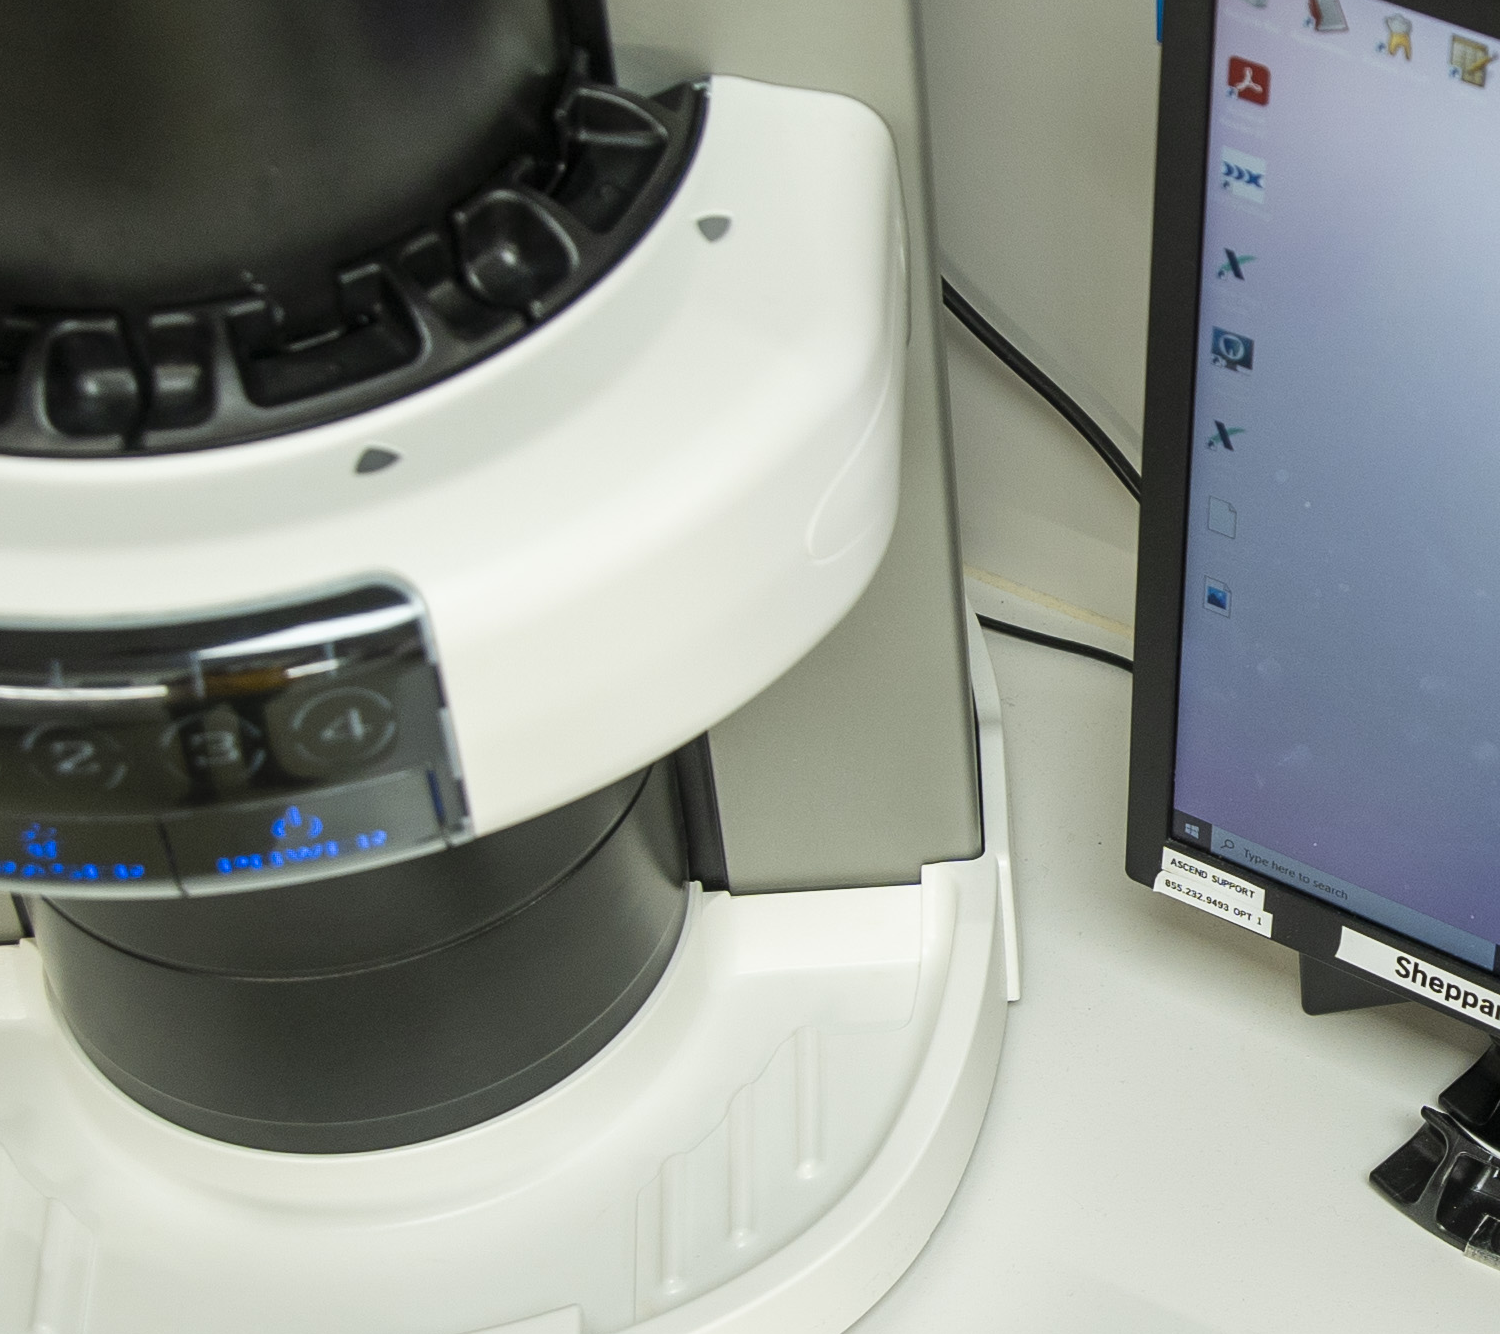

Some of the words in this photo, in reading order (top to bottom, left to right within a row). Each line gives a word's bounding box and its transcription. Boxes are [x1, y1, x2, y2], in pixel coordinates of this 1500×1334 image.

[1170, 858, 1207, 879] ASCEND
[1211, 875, 1255, 899] SUPPORT
[1244, 850, 1269, 867] Type
[1272, 860, 1296, 877] here
[1298, 873, 1310, 884] to
[1313, 880, 1348, 900] search
[1165, 879, 1229, 912] 855.232.9493
[1233, 908, 1252, 921] OPT
[1257, 917, 1262, 925] 1
